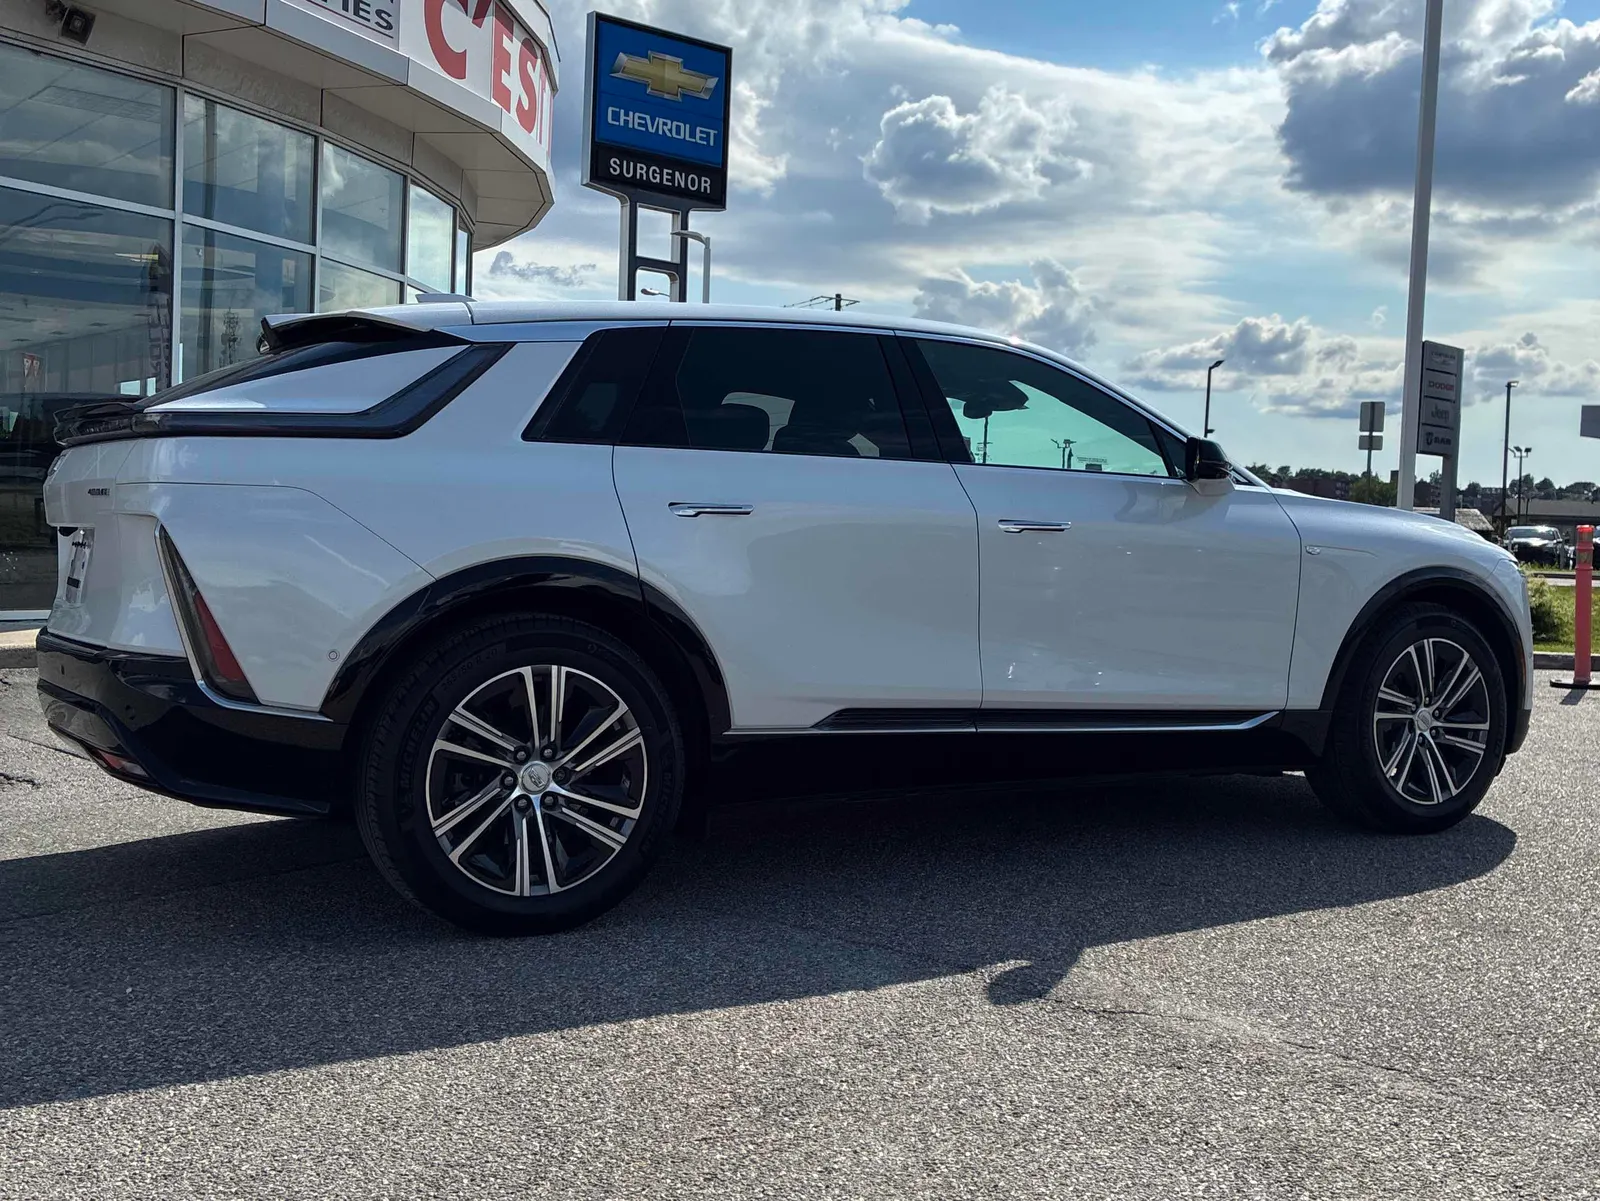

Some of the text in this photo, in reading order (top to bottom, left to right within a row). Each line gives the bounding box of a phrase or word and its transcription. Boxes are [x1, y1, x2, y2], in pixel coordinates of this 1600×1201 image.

[322, 0, 394, 31] IES
[607, 106, 718, 147] CHEVROLET
[609, 157, 711, 194] SURGENOR
[400, 699, 437, 788] MICHELIN
